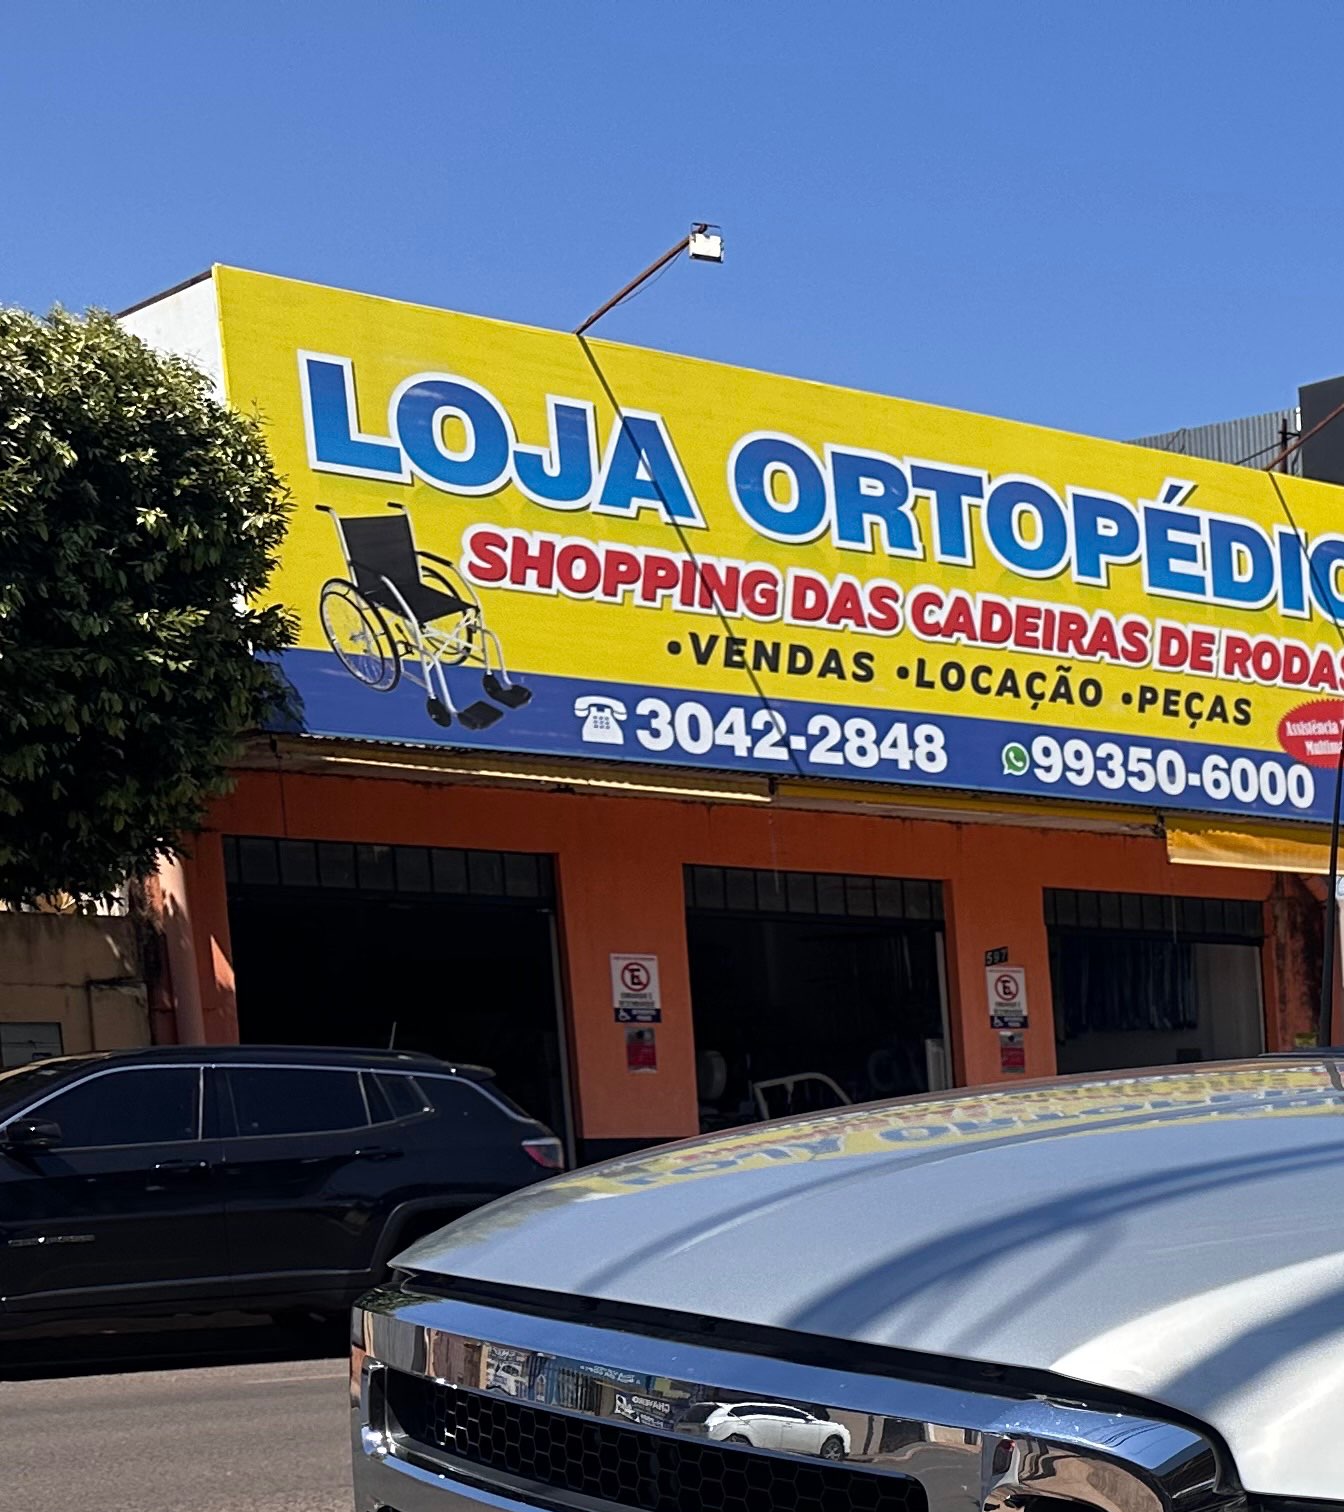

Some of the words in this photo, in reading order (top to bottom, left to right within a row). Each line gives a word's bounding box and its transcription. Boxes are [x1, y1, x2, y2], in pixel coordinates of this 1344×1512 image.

[298, 350, 707, 529] LOJA
[463, 526, 780, 624] SHOPPING
[788, 573, 904, 637] DAS
[908, 588, 1150, 667] CADEIRAS
[1155, 623, 1219, 676] DE
[635, 698, 948, 773] 3042-2848
[1031, 735, 1316, 809] 99350-6000
